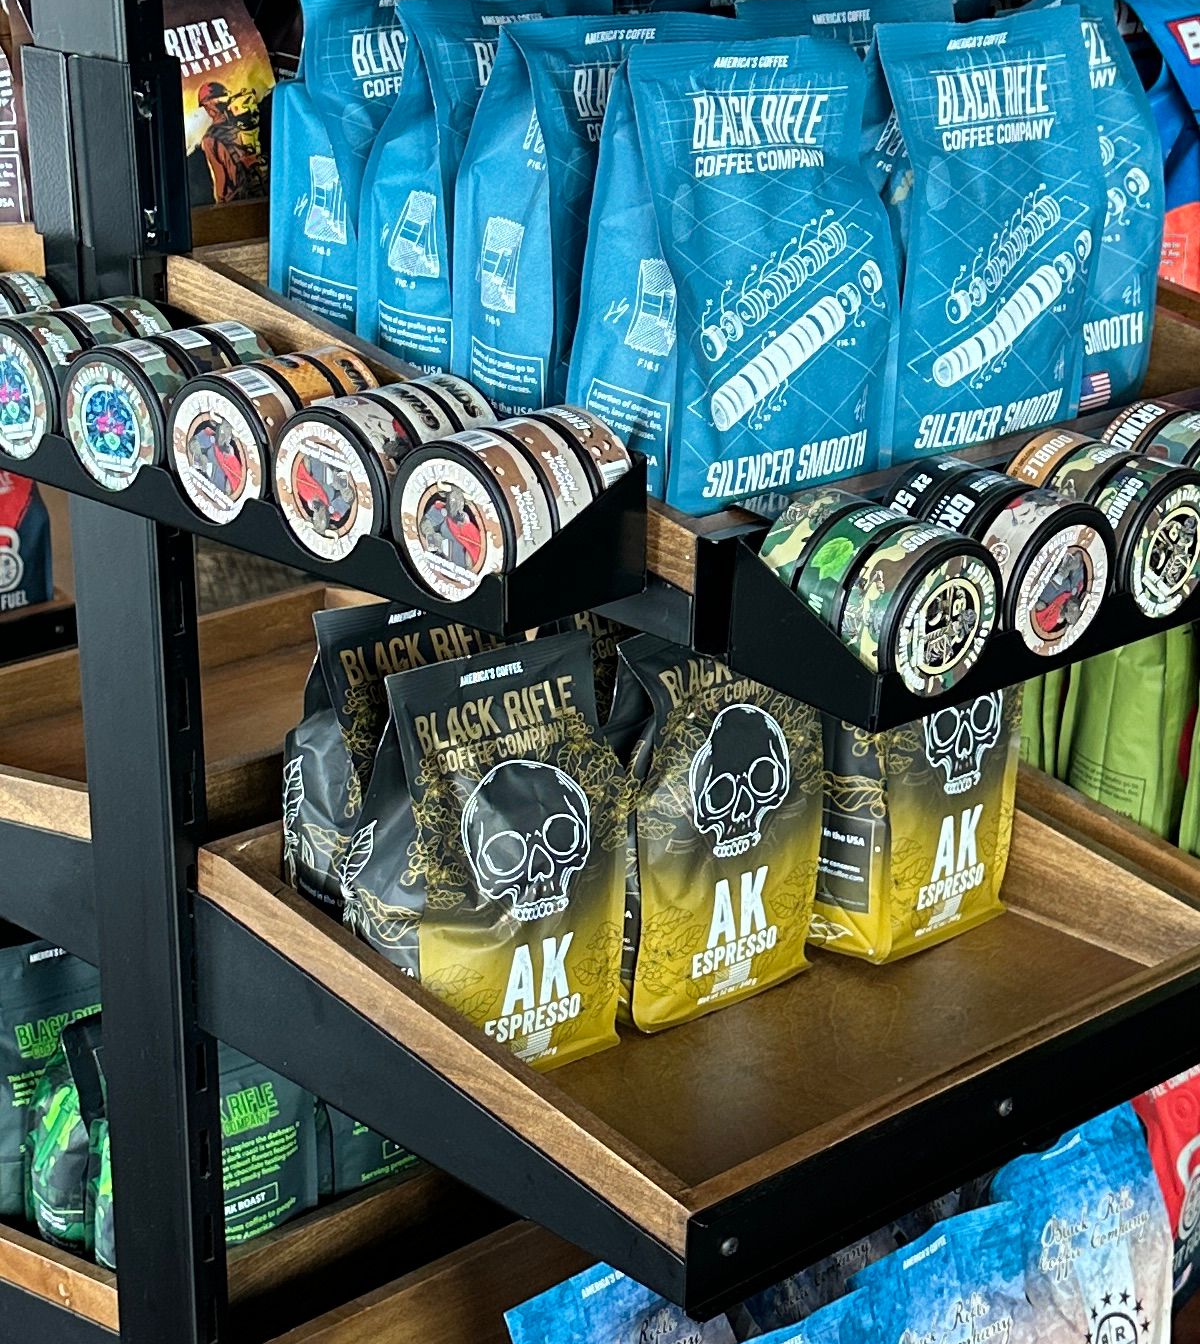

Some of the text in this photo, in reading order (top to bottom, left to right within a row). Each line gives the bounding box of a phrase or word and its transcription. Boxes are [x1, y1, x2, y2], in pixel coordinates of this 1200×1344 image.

[585, 28, 656, 45] AMERICA'S COFFEE
[812, 9, 870, 24] AMERICA'S COFFEE
[164, 17, 237, 63] RIFLE
[947, 32, 1008, 51] AMERICA'S COFFEE
[714, 55, 789, 68] AMERICA'S COFFEE
[936, 64, 1049, 125] BLACK RIFLE
[692, 94, 828, 149] BLACK RIFLE
[942, 118, 1054, 152] COFFEE COMPANY
[695, 149, 824, 178] COFFEE COMPANY
[1083, 311, 1144, 356] SMOOTH
[424, 365, 442, 375] USA
[514, 405, 532, 416] USA
[914, 388, 1062, 450] SILENCER SMOOTH
[1111, 403, 1166, 452] GRIND
[554, 454, 579, 491] MOCHA
[702, 430, 867, 498] SILENCER SMOOTH
[1023, 434, 1073, 479] DOUBLE
[911, 473, 933, 492] 2X
[522, 490, 541, 530] MOCHA
[2, 591, 29, 610] FUEL
[339, 631, 428, 686] BLACK
[459, 662, 523, 687] AMERICA'S COFFEE
[415, 675, 576, 757] BLACK RIFLE
[437, 722, 568, 774] COFFEE COMPANY
[833, 829, 845, 842] the
[846, 833, 865, 847] USA
[931, 804, 983, 883] AK
[706, 865, 769, 949] AK
[916, 862, 984, 911] ESPRESSO
[691, 925, 778, 980] ESPRESSO
[500, 931, 574, 1017] AK
[15, 1013, 69, 1051] BLACK
[484, 992, 581, 1043] ESPRESSO
[226, 1081, 277, 1117] RIFLE
[223, 1108, 270, 1136] COMPANY
[238, 1192, 266, 1211] ROAST
[929, 1234, 946, 1255] COFFEE
[1040, 1200, 1088, 1248] Black
[1090, 1209, 1151, 1250] Company
[950, 1291, 990, 1334] Rifle
